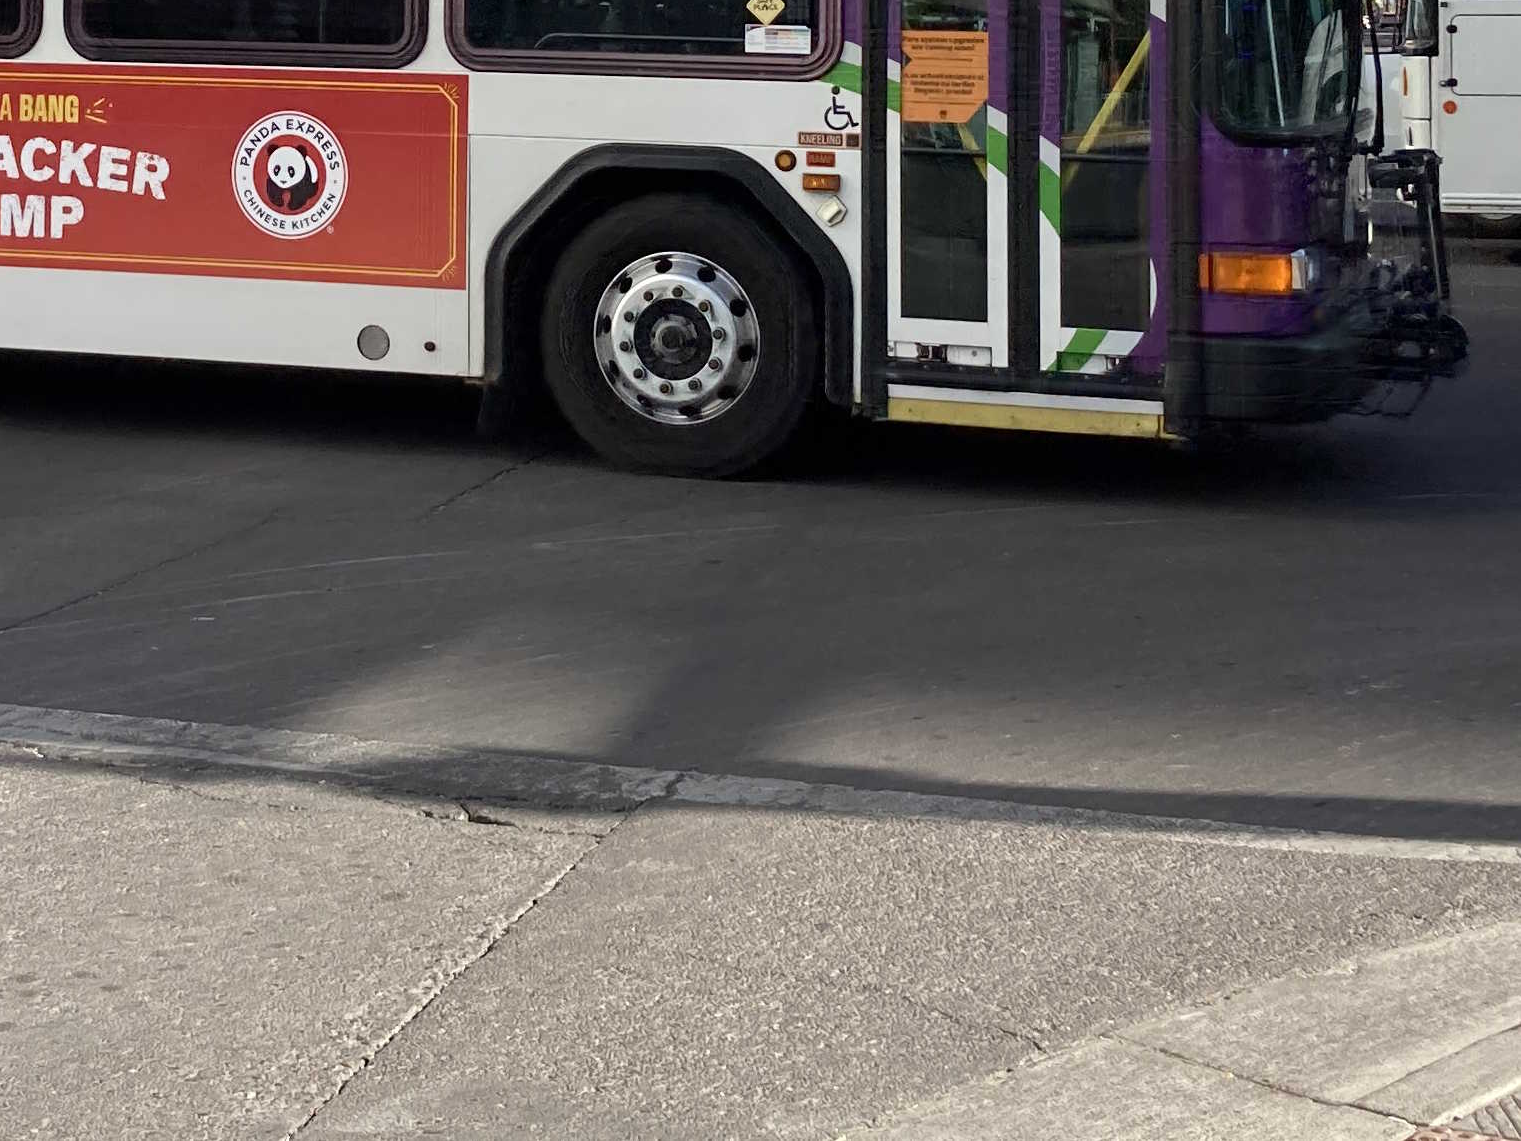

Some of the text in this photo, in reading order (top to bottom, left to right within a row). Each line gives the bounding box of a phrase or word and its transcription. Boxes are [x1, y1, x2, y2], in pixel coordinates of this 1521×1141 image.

[0, 93, 13, 121] A
[19, 94, 79, 123] BANG
[239, 118, 340, 170] PANDA EXPRESS
[800, 133, 841, 145] KNEELING
[244, 189, 336, 230] CHINESE KITCHEN
